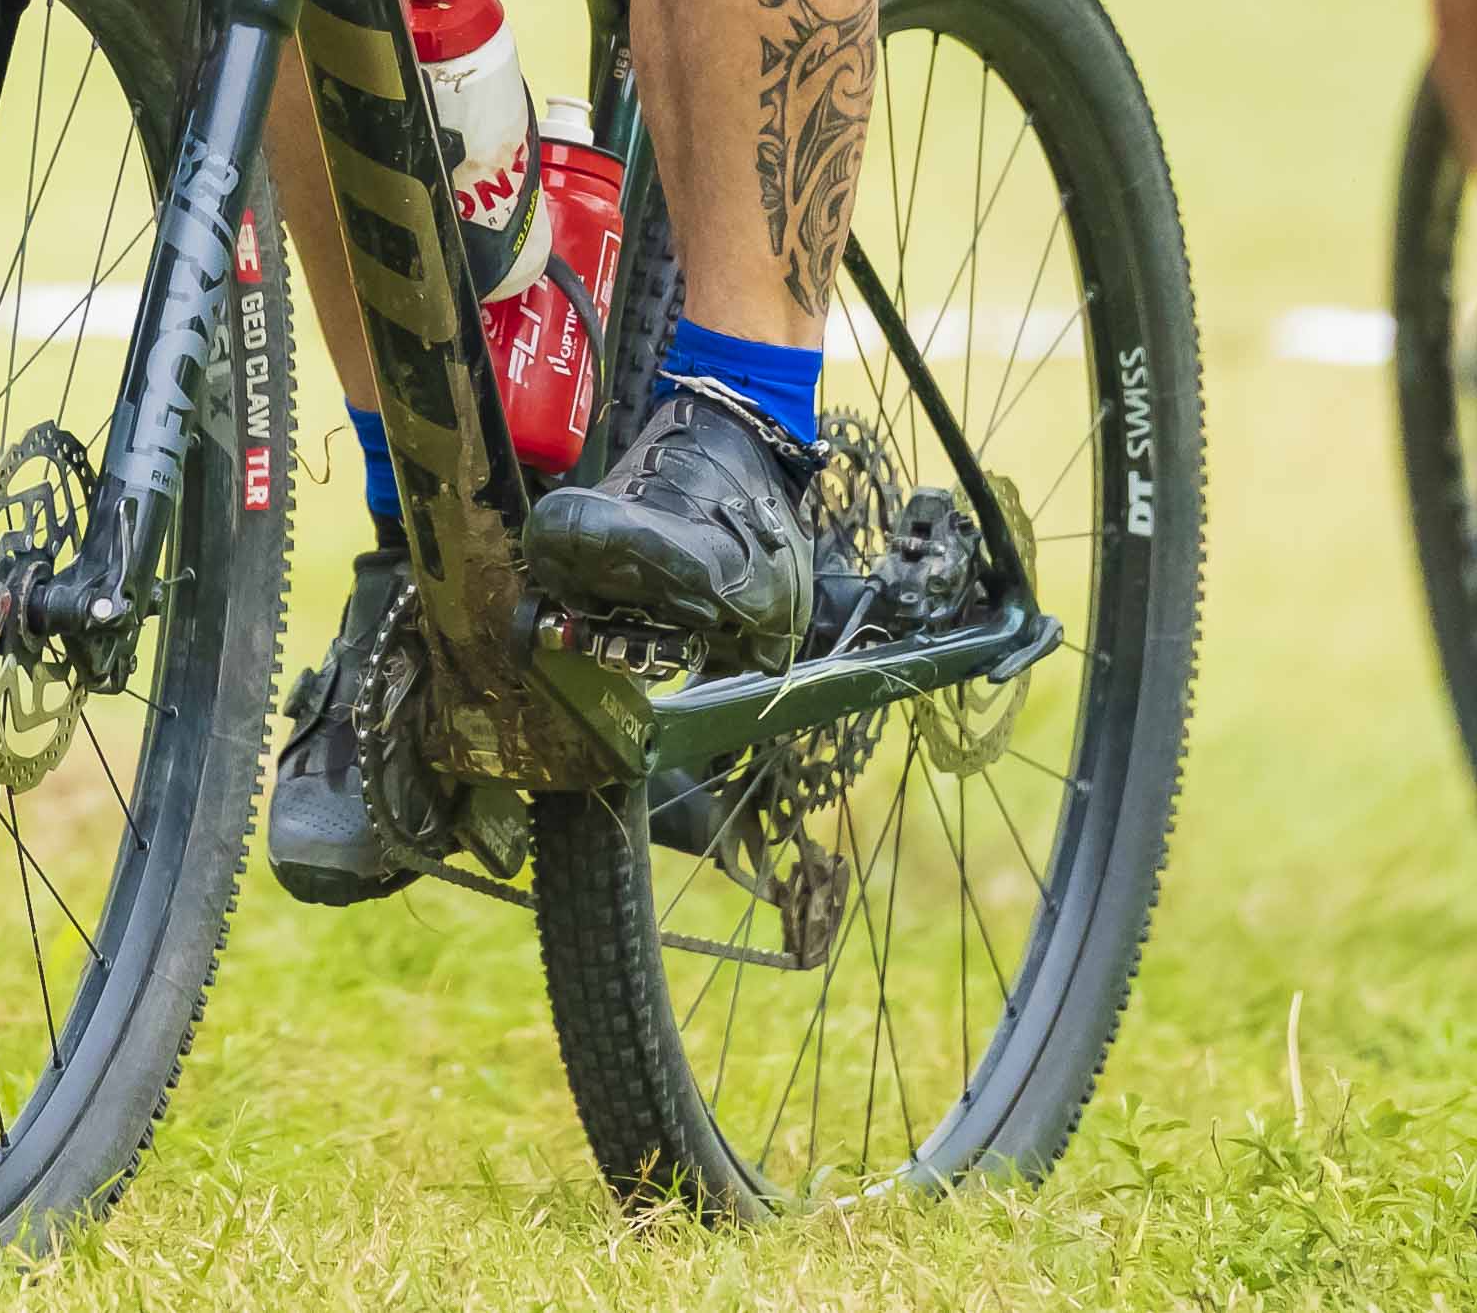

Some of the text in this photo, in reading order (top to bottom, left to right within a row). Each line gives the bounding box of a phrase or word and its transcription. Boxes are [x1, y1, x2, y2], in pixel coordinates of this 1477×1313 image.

[241, 290, 271, 505] GEO CLAW TLR
[1118, 345, 1156, 537] DT SWISS
